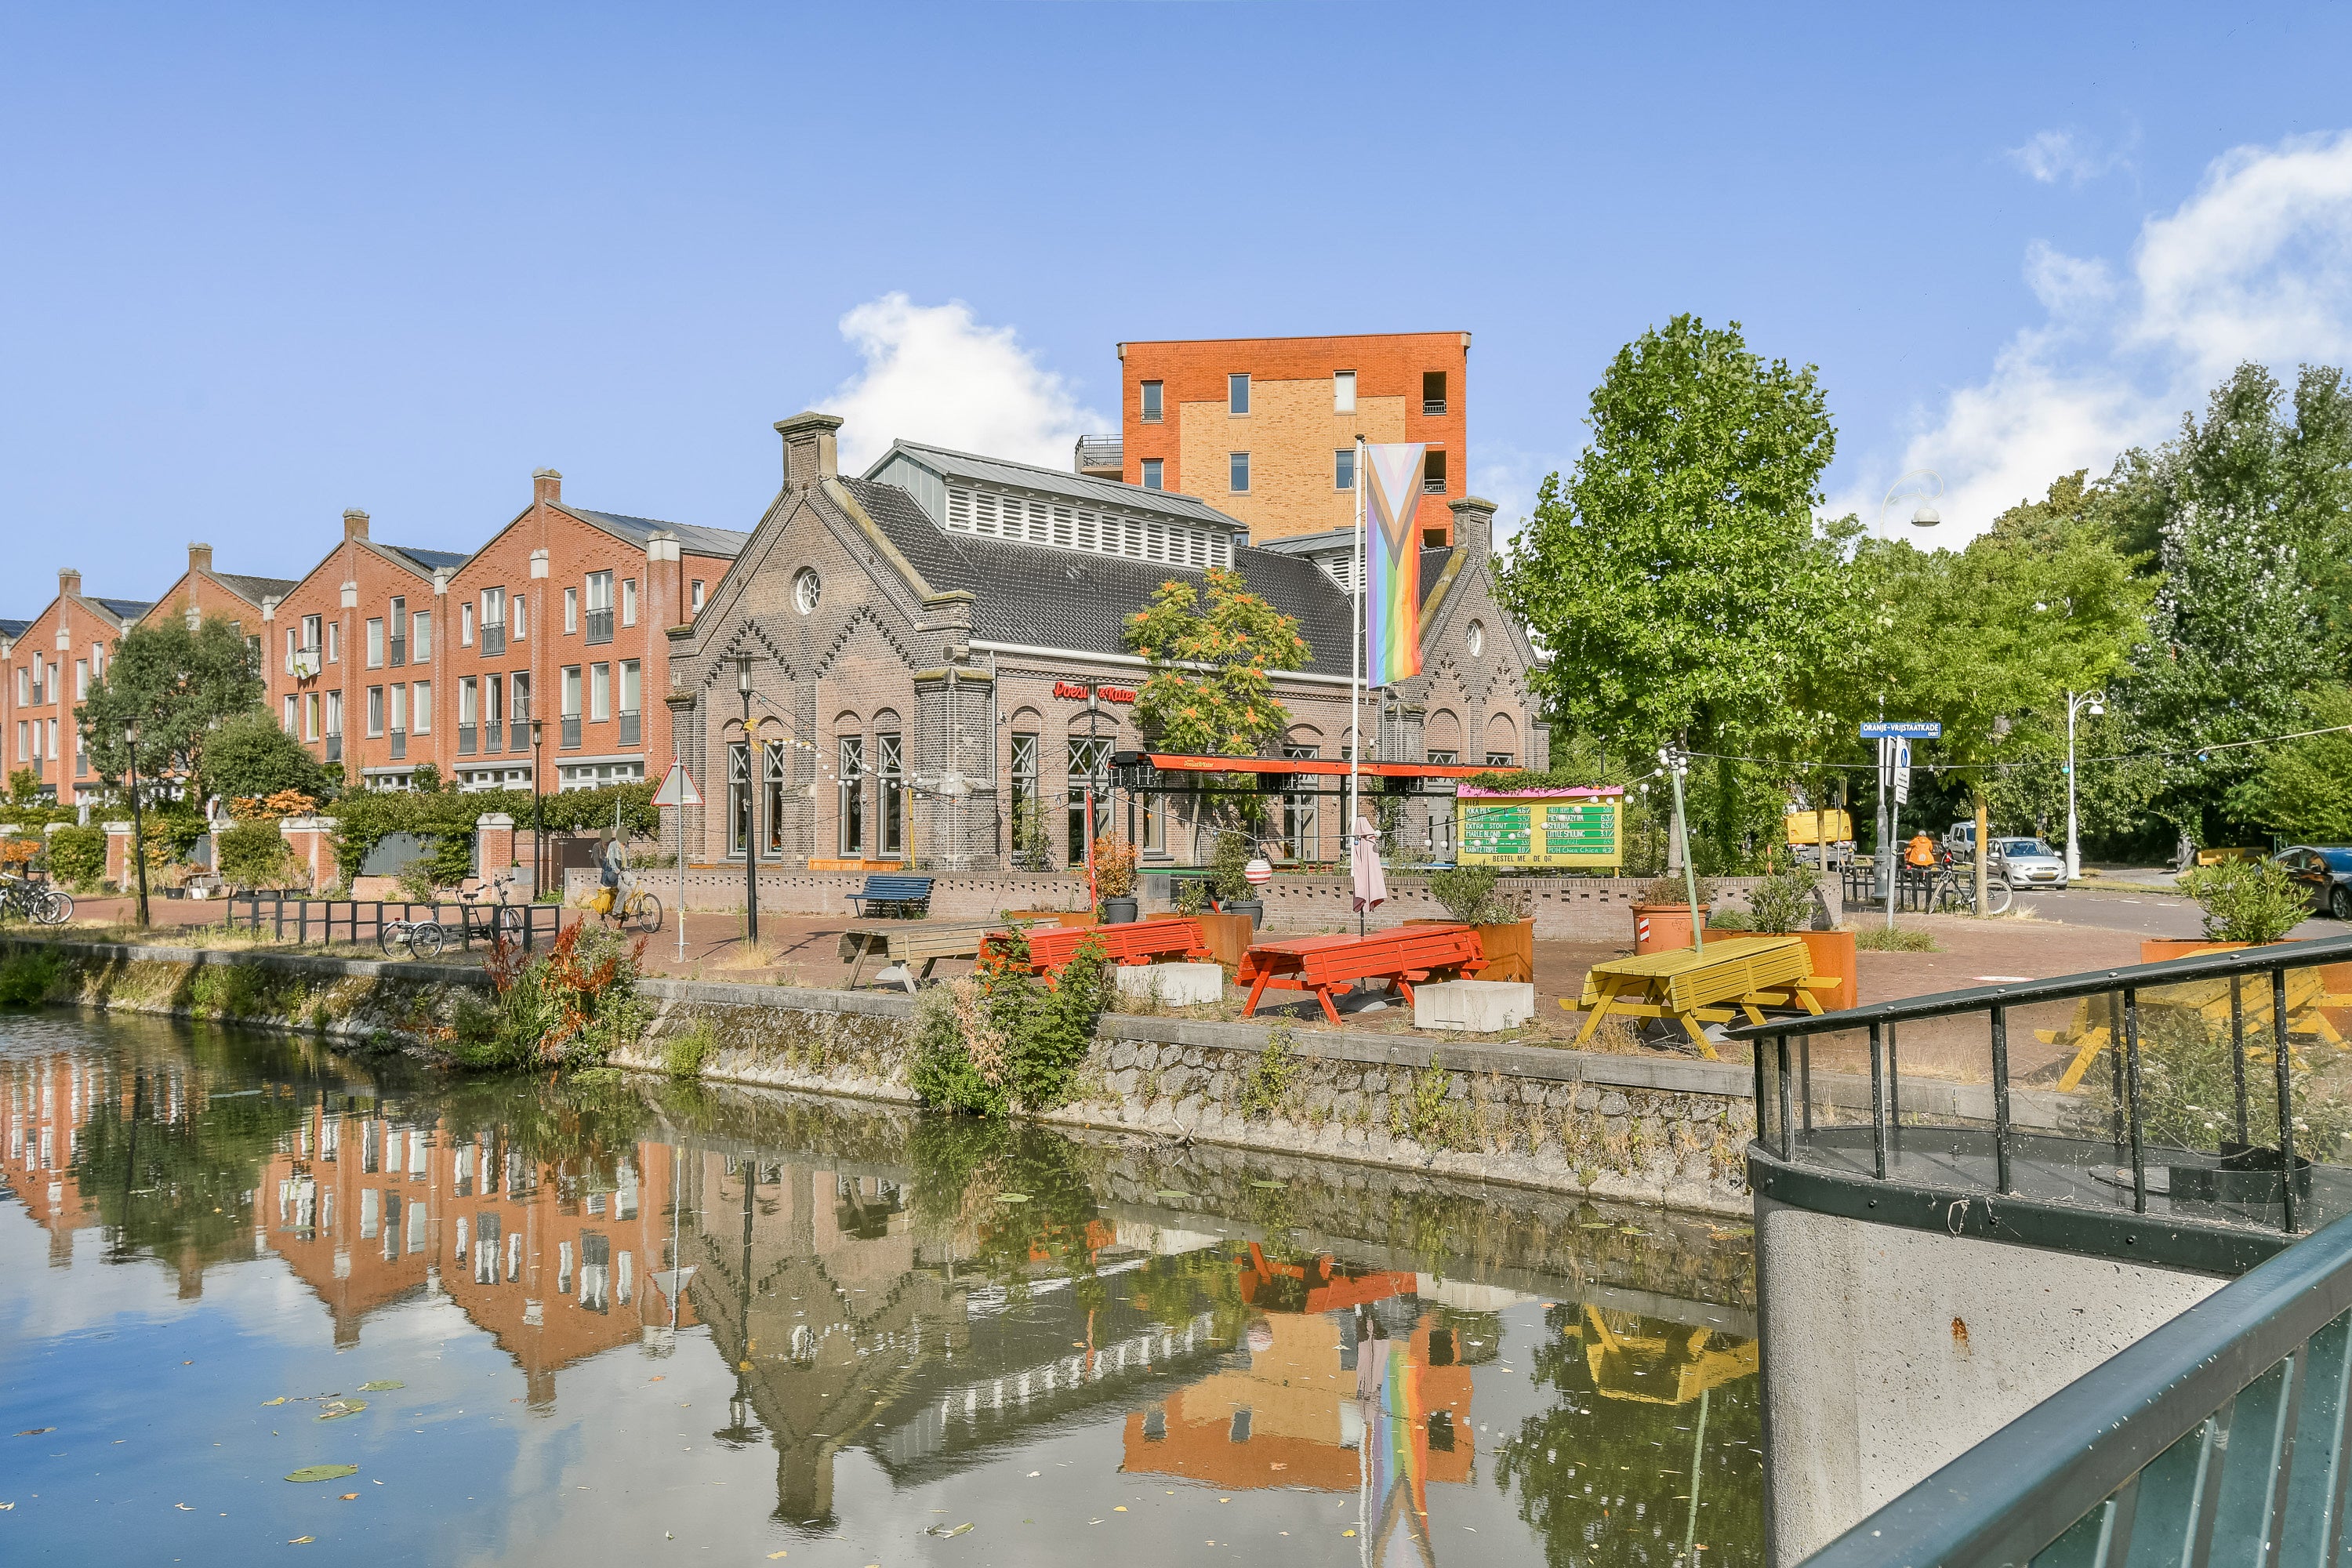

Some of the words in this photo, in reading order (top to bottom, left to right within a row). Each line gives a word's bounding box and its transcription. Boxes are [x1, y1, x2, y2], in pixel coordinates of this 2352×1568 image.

[1054, 681, 1089, 699] Poesi
[1098, 688, 1106, 698] &
[1863, 724, 1939, 732] ORANJE-VRIJSTAATKADE
